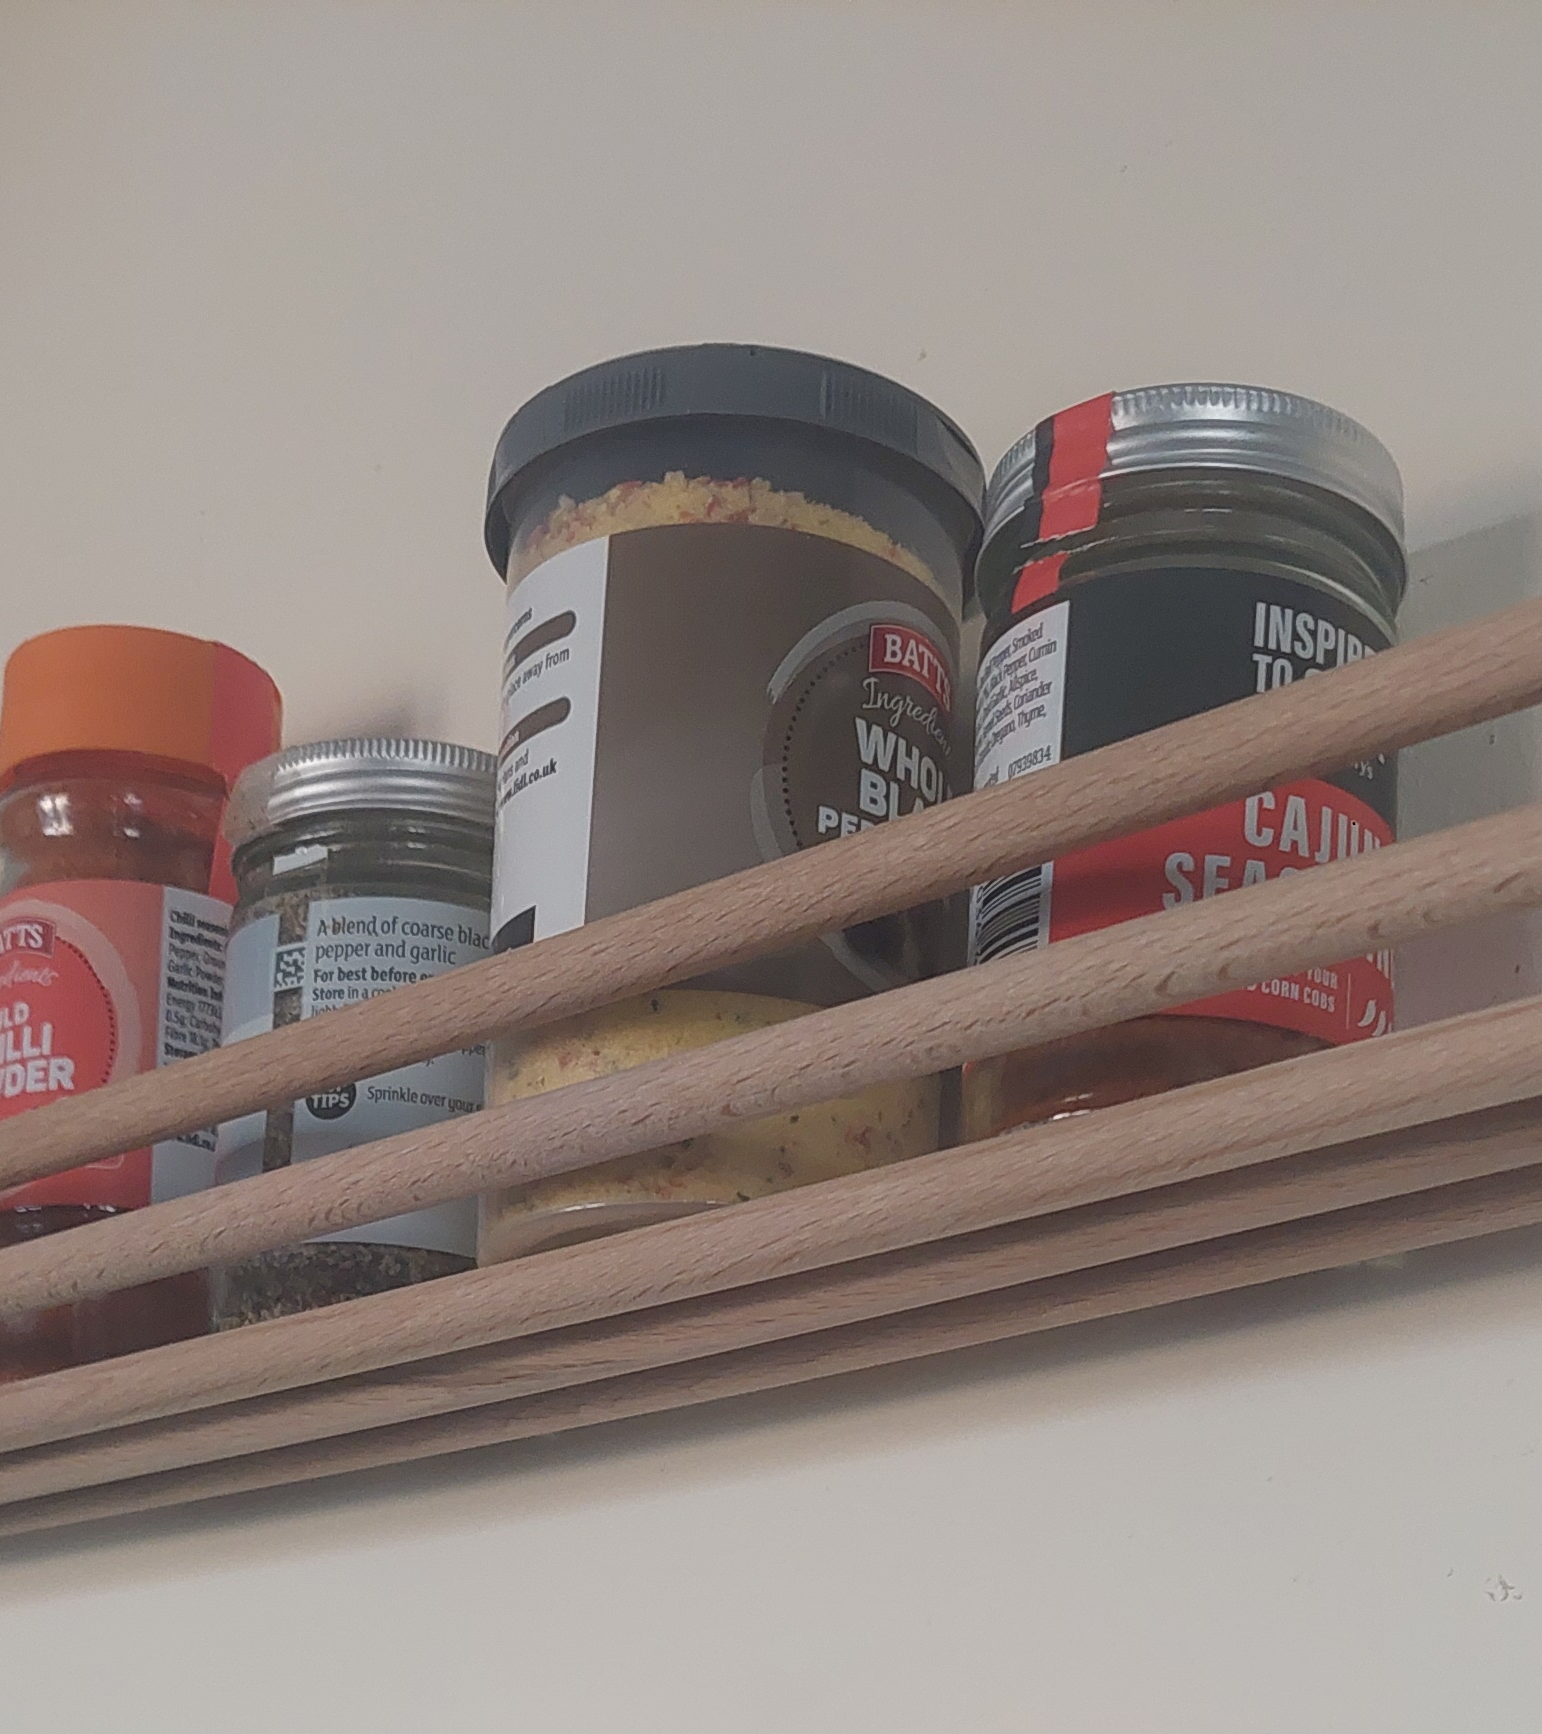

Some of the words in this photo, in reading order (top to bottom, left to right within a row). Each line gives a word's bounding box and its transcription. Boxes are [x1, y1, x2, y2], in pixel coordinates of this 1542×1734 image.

[544, 647, 570, 671] from
[884, 633, 951, 712] BATTS
[1013, 681, 1054, 711] Coriander
[855, 716, 954, 804] WHOL
[1162, 852, 1301, 911] SEA
[316, 919, 328, 938] A
[330, 915, 379, 937] blend
[380, 915, 399, 937] of
[401, 919, 455, 942] coarse
[315, 942, 371, 965] pepper
[373, 939, 407, 960] and
[409, 944, 457, 967] garlic
[313, 968, 335, 984] For
[336, 966, 368, 983] best
[370, 965, 418, 984] before
[312, 986, 346, 1002] Store
[347, 985, 359, 1000] in
[361, 988, 369, 1000] a
[1303, 986, 1337, 1014] COBS
[310, 1092, 352, 1110] TIPS
[366, 1085, 417, 1106] Sprinkle
[419, 1093, 447, 1107] over
